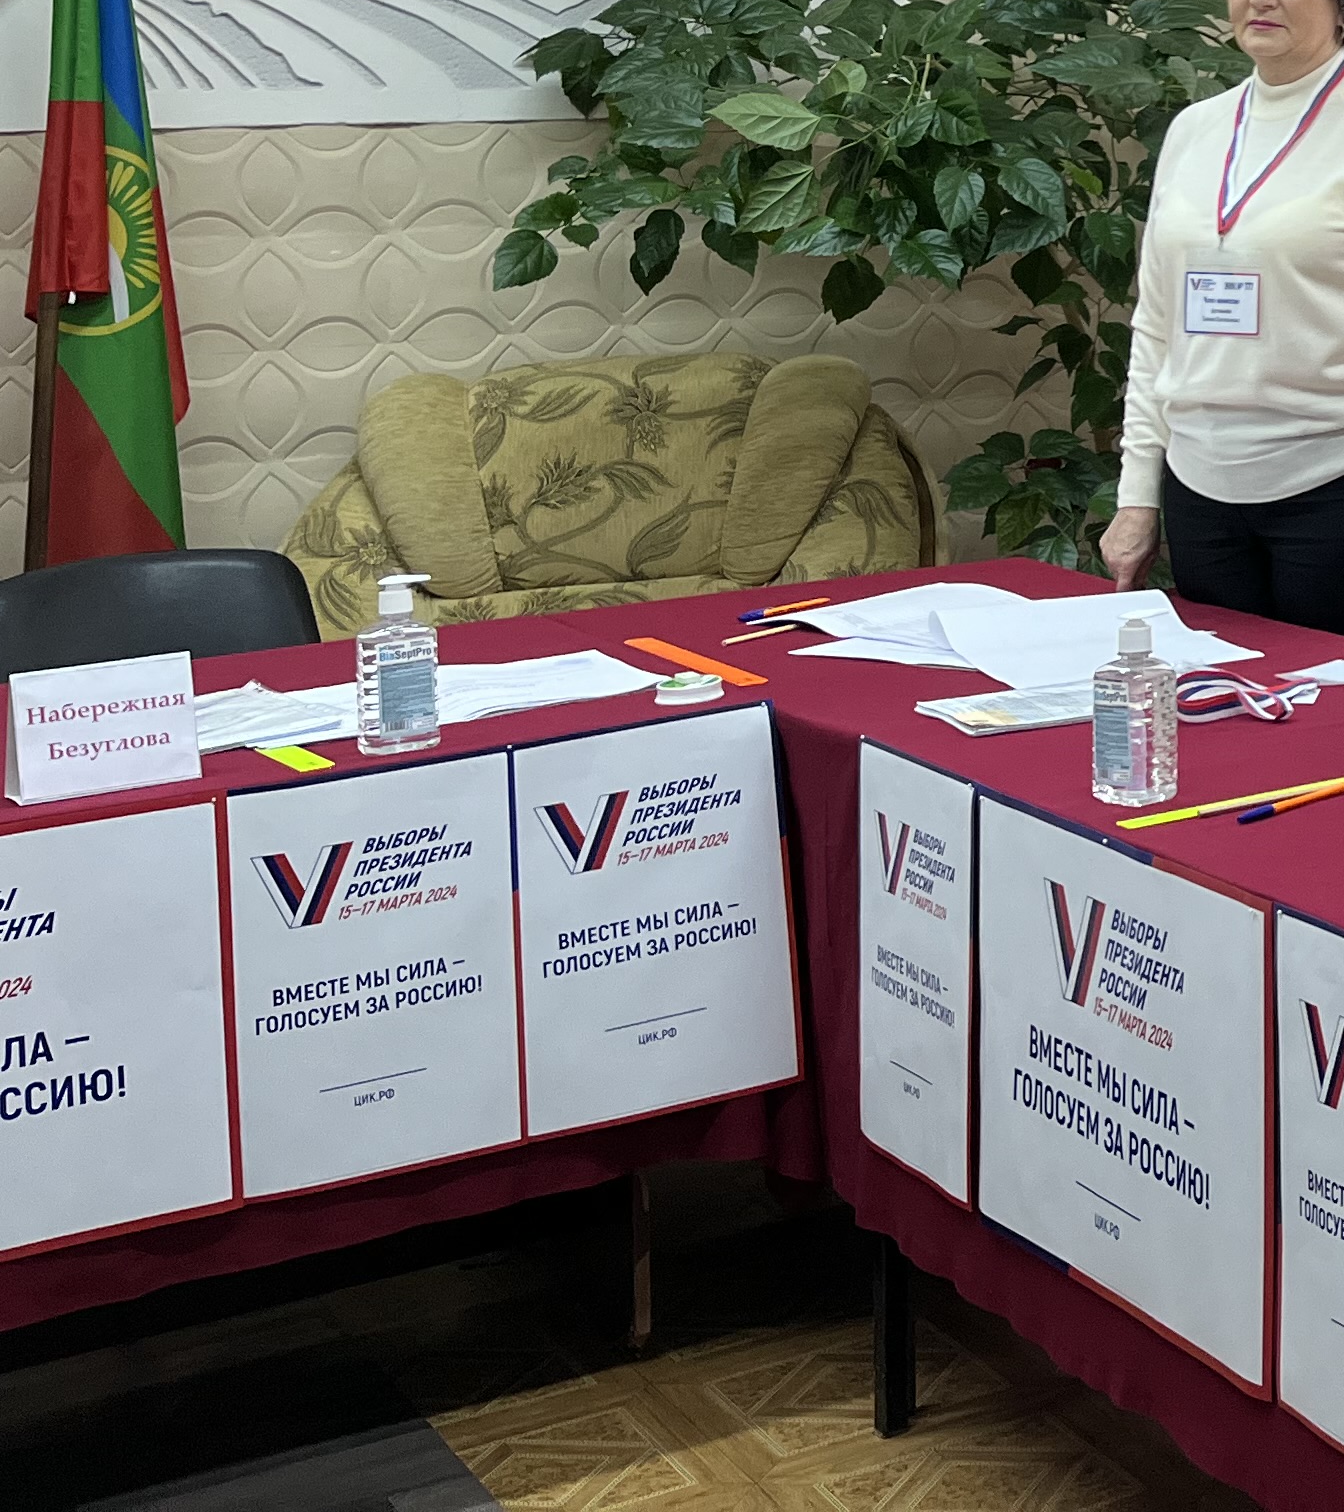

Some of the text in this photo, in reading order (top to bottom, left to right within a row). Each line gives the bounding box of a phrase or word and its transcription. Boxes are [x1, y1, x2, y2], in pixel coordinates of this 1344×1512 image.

[27, 693, 184, 725] Набережная
[48, 732, 169, 760] Безуглова
[638, 774, 717, 802] ВЫБОРЫ
[630, 789, 741, 824] ПРЕЗИДЕНТА
[362, 824, 447, 854] ВЫБОРЫ
[622, 818, 694, 847] РОССИИ
[653, 837, 696, 859] МАРТА
[698, 831, 729, 849] 2024
[913, 828, 946, 856] ВЫБОРЫ
[353, 841, 472, 877] ПРЕЗИДЕНТА
[908, 848, 955, 883] ПРЕЗИДЕНТА
[344, 871, 421, 900] РОССИИ
[376, 891, 422, 912] МАРТА
[424, 884, 457, 904] 2024
[904, 868, 934, 894] РОССИИ
[558, 904, 722, 950] ВМЕСТЕ МЫ СИЛА
[1111, 909, 1167, 952] ВЫБОРЫ
[543, 918, 756, 978] ГОЛОСУЕМ ЗА РОССИЮ!
[1105, 939, 1184, 993] ПРЕЗИДЕНТА
[272, 960, 447, 1006] ВМЕСТЕ МЫ СИЛА
[877, 945, 942, 995] ВМЕСТЕ МЫ СИЛА
[255, 975, 482, 1035] ГОЛОСУЕМ ЗА РОССИЮ!
[871, 967, 955, 1027] ГОЛОСУЕМ ЗА РОССИЮ!
[1098, 968, 1147, 1010] РОССИИ
[638, 1027, 677, 1045] ЦИК.РФ
[1117, 1009, 1147, 1040] МАРТА
[1147, 1024, 1173, 1051] 2024
[1, 1031, 54, 1072] ЛА
[1, 1065, 126, 1120] ССИЮ!
[1029, 1025, 1178, 1130] ВМЕСТЕ МЫ СИЛА
[354, 1088, 395, 1106] ЦИК.РФ
[1013, 1069, 1209, 1208] ГОЛОСУЕМ ЗА РОССИЮ!
